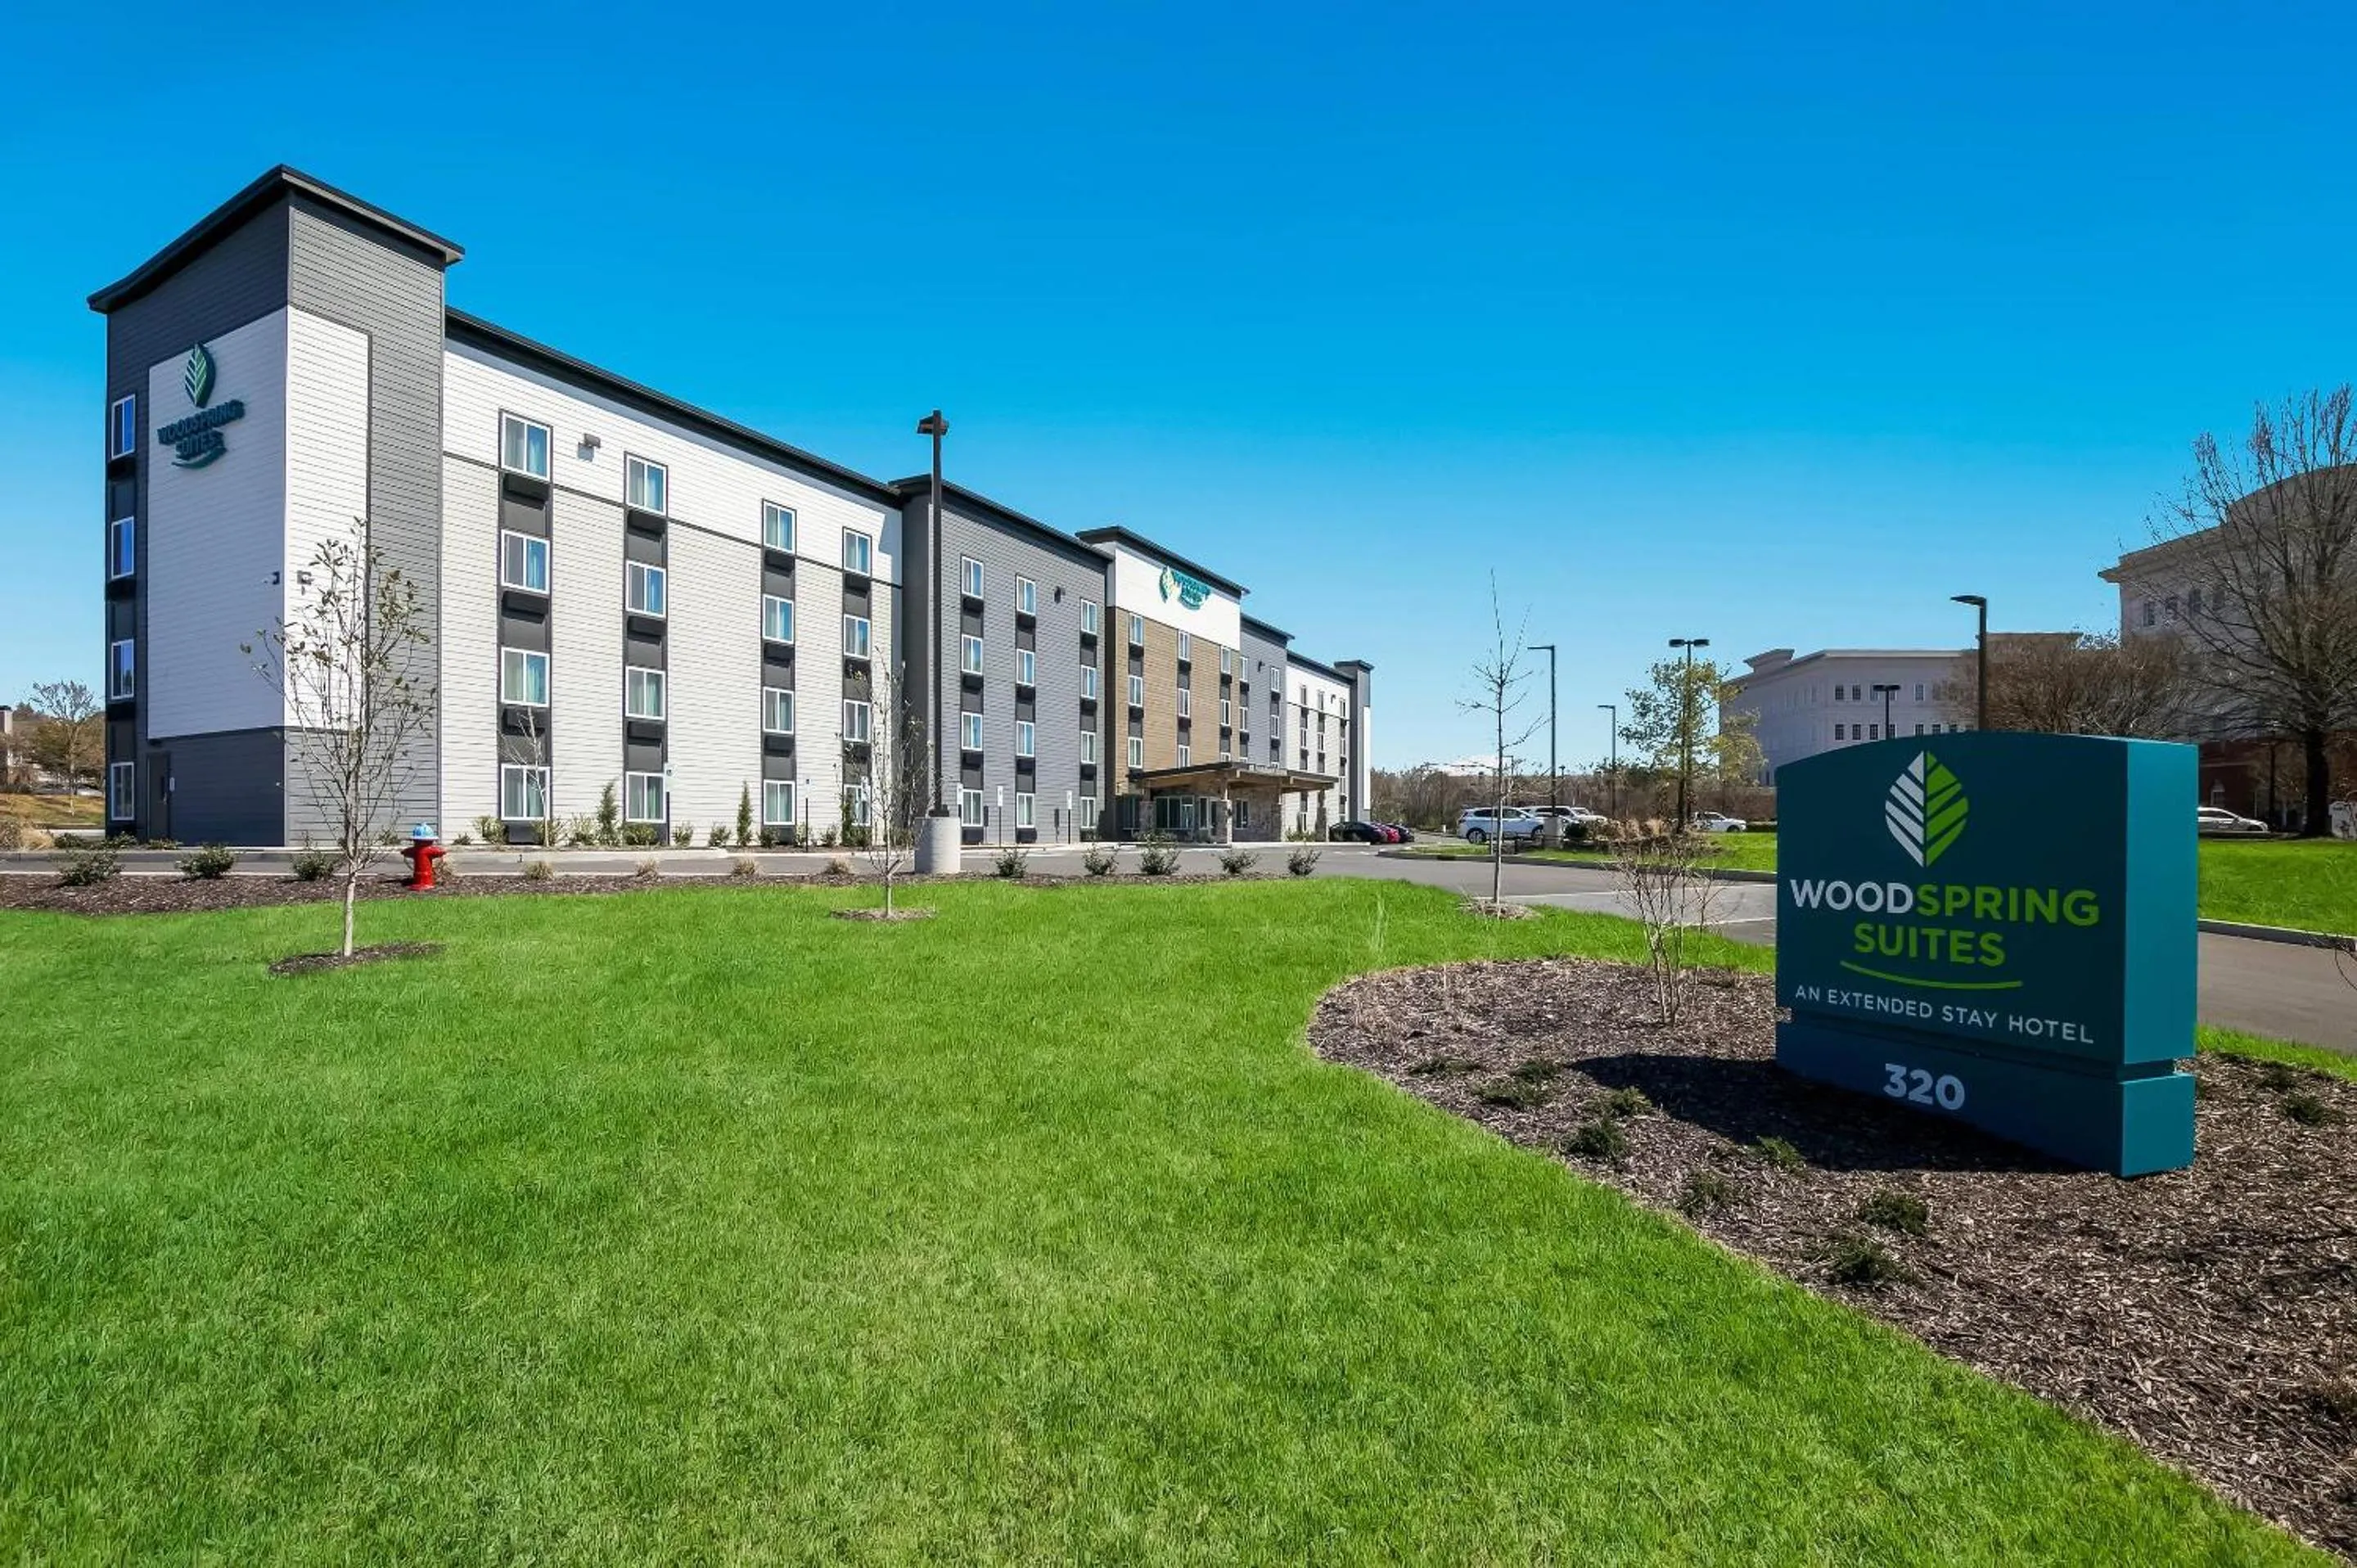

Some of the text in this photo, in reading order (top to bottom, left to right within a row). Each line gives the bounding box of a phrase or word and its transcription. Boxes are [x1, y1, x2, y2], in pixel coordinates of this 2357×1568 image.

[1790, 880, 2100, 926] WOODSPRING
[1854, 923, 2006, 967] SUITES
[1796, 985, 2093, 1044] AN EXTENDED STAY HOTEL
[1883, 1063, 1965, 1111] 320
